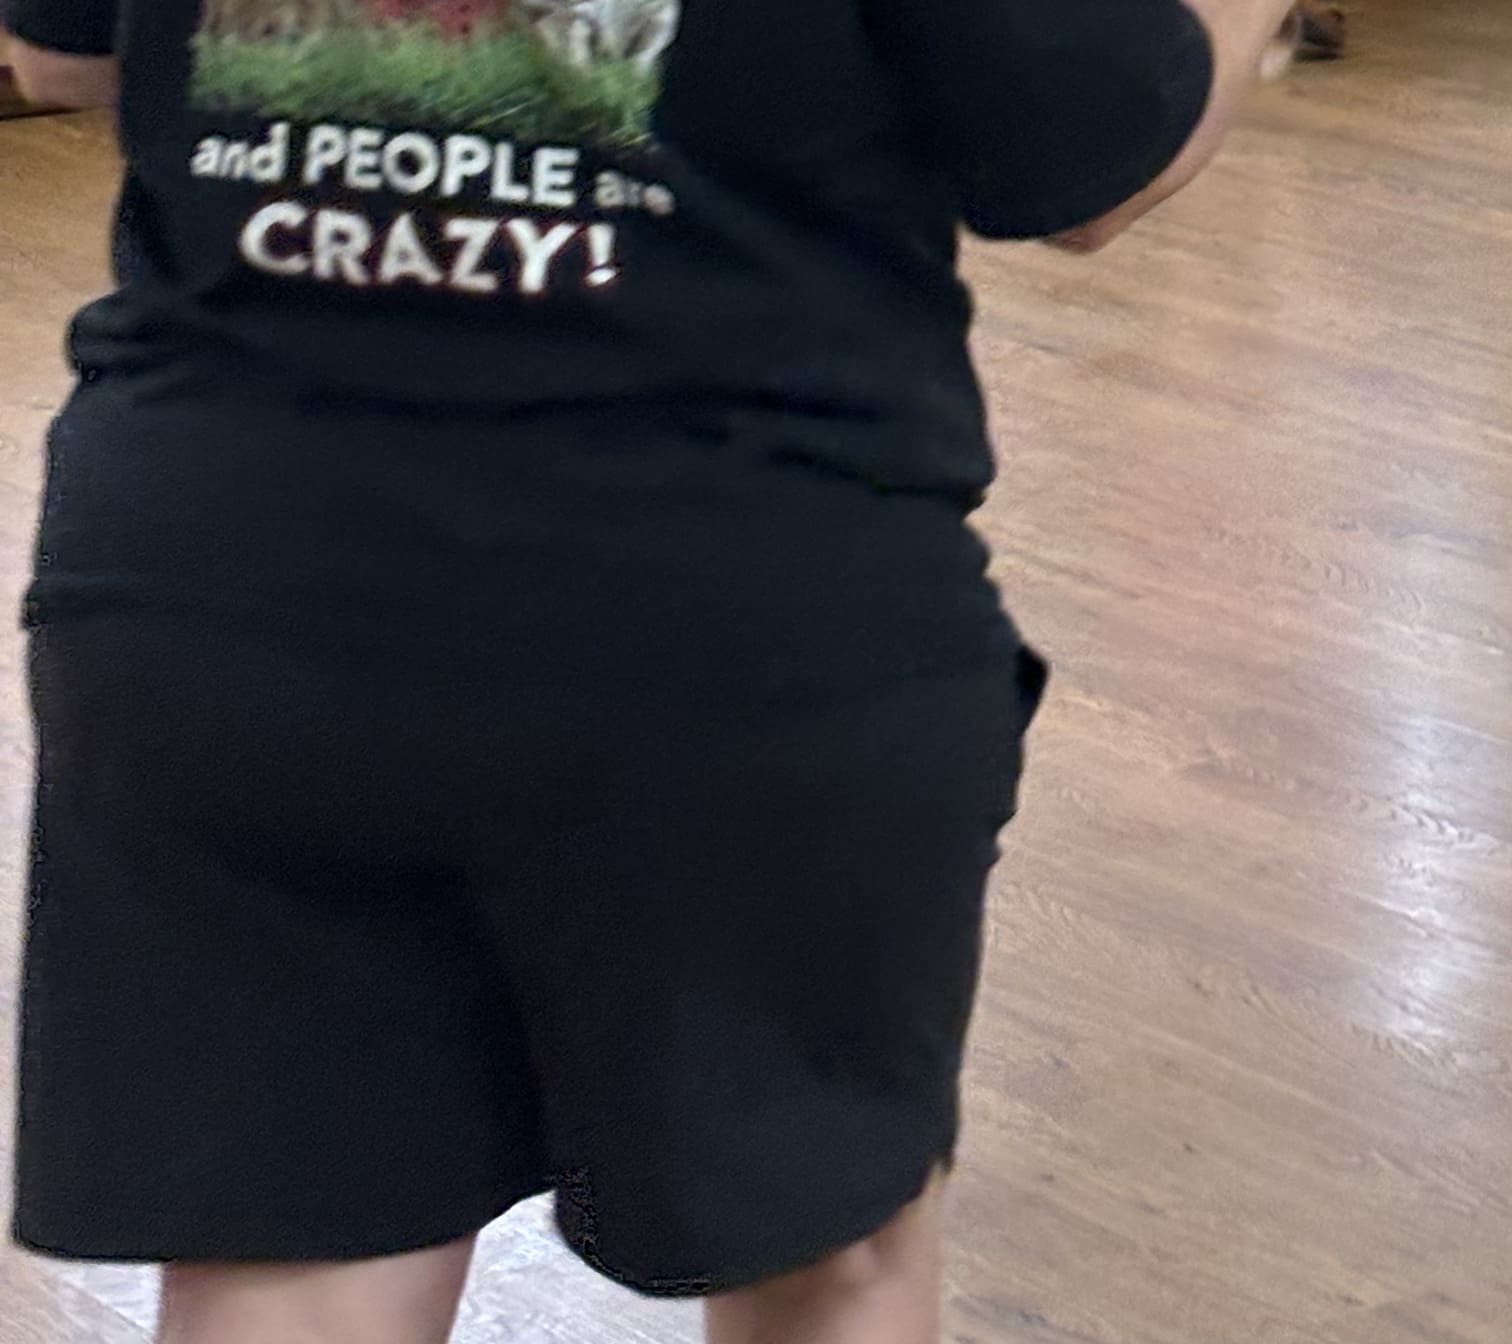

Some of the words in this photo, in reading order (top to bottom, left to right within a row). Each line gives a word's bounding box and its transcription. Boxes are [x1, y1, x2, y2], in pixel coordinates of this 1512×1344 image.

[190, 121, 291, 184] and
[303, 123, 581, 208] PEOPLE
[238, 199, 622, 295] CRAZY!
